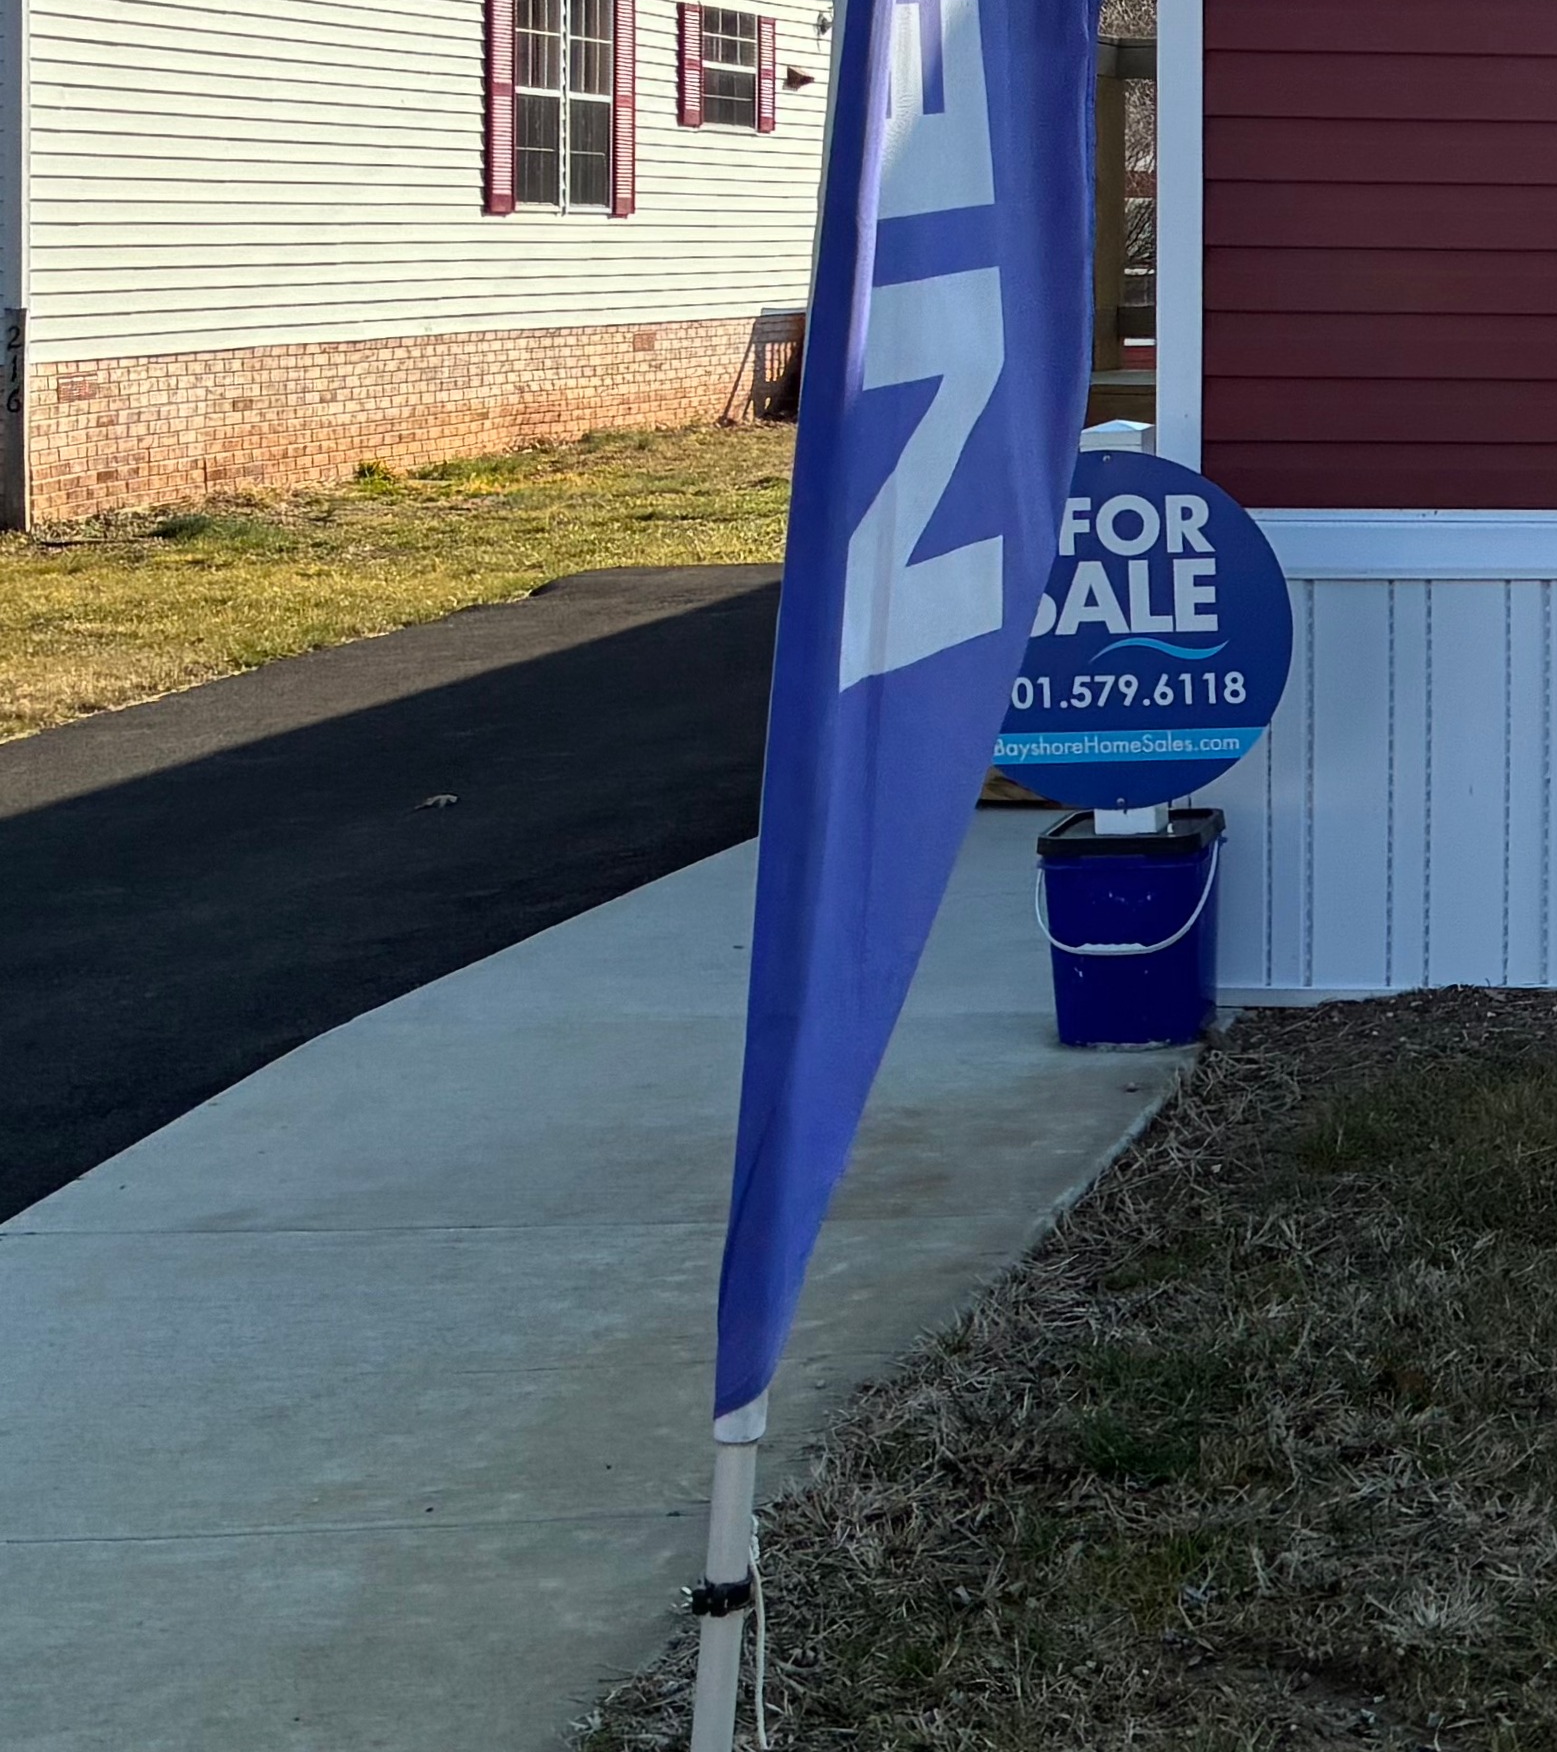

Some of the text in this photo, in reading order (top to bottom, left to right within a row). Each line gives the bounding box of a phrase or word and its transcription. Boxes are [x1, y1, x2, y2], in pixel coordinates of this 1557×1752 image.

[7, 325, 22, 413] 216
[1059, 494, 1216, 556] FOR
[1011, 671, 1247, 709] 01.579.6118
